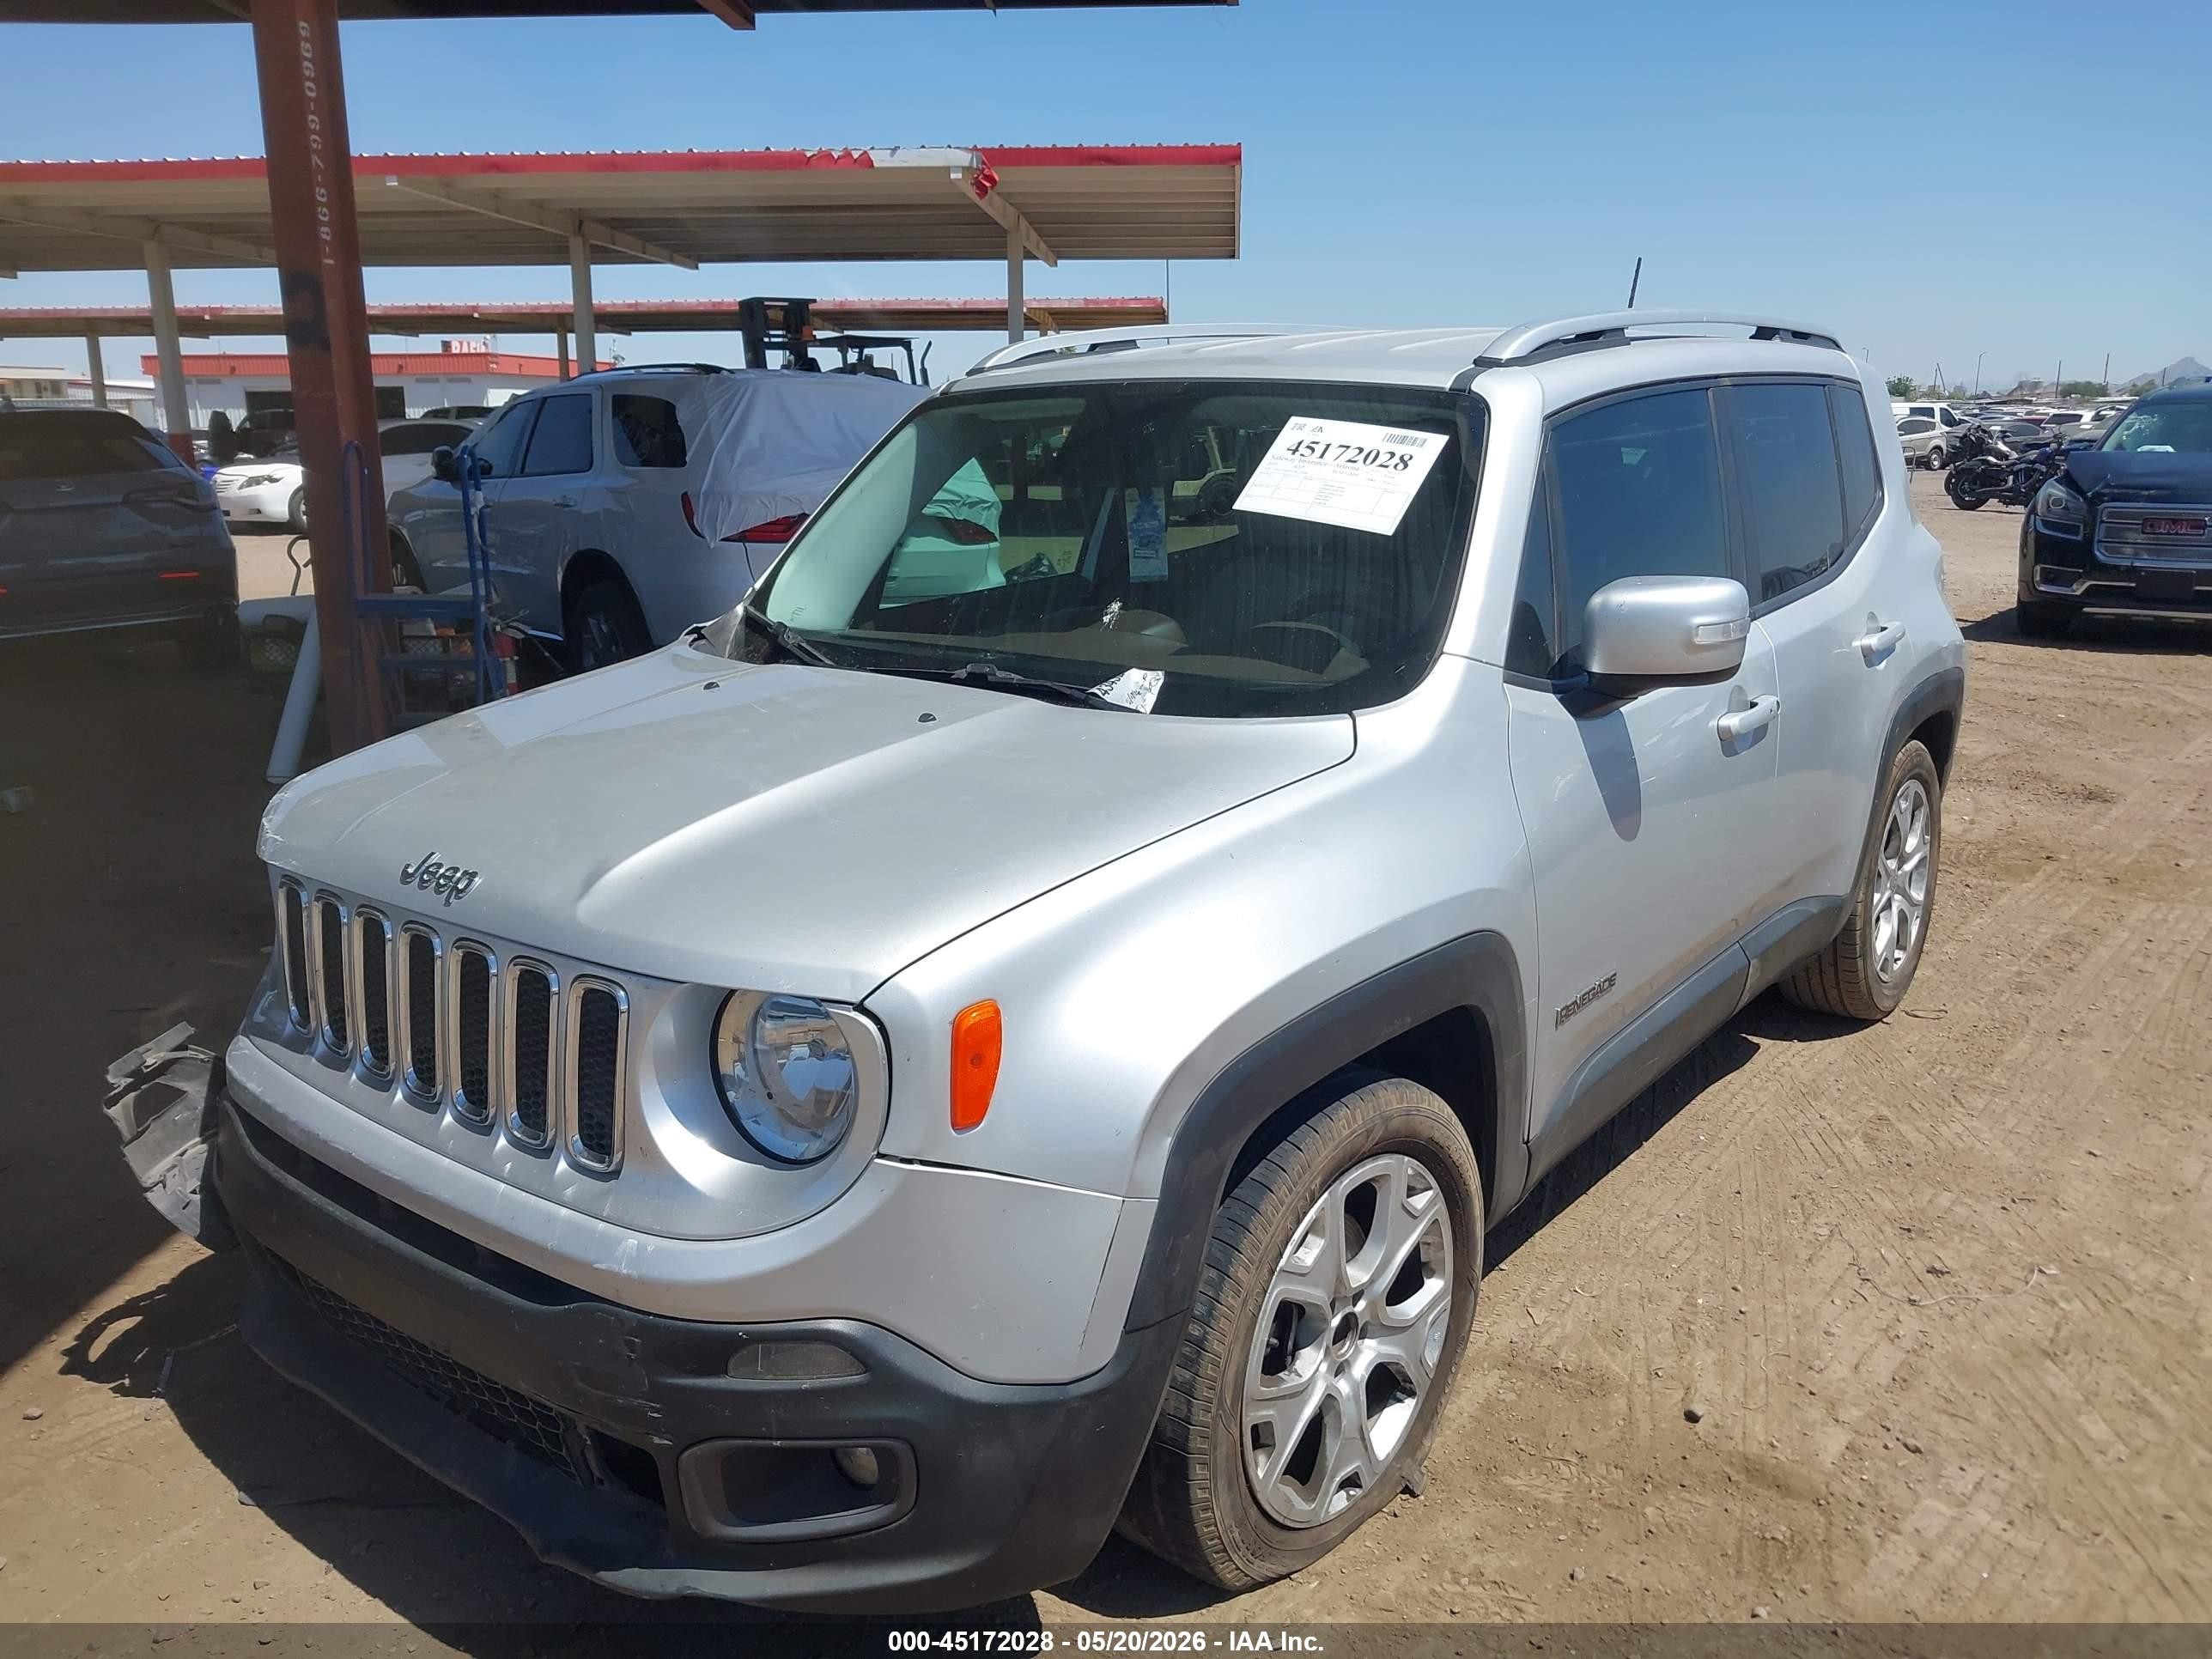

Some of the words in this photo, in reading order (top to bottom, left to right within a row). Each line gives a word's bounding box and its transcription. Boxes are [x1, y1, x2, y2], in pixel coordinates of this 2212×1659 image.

[298, 21, 336, 265] 1-866-799-0969
[1286, 439, 1413, 471] 45172028
[2145, 520, 2204, 535] GMC
[399, 851, 483, 908] Jeep
[1554, 970, 1618, 1031] RENEGADE
